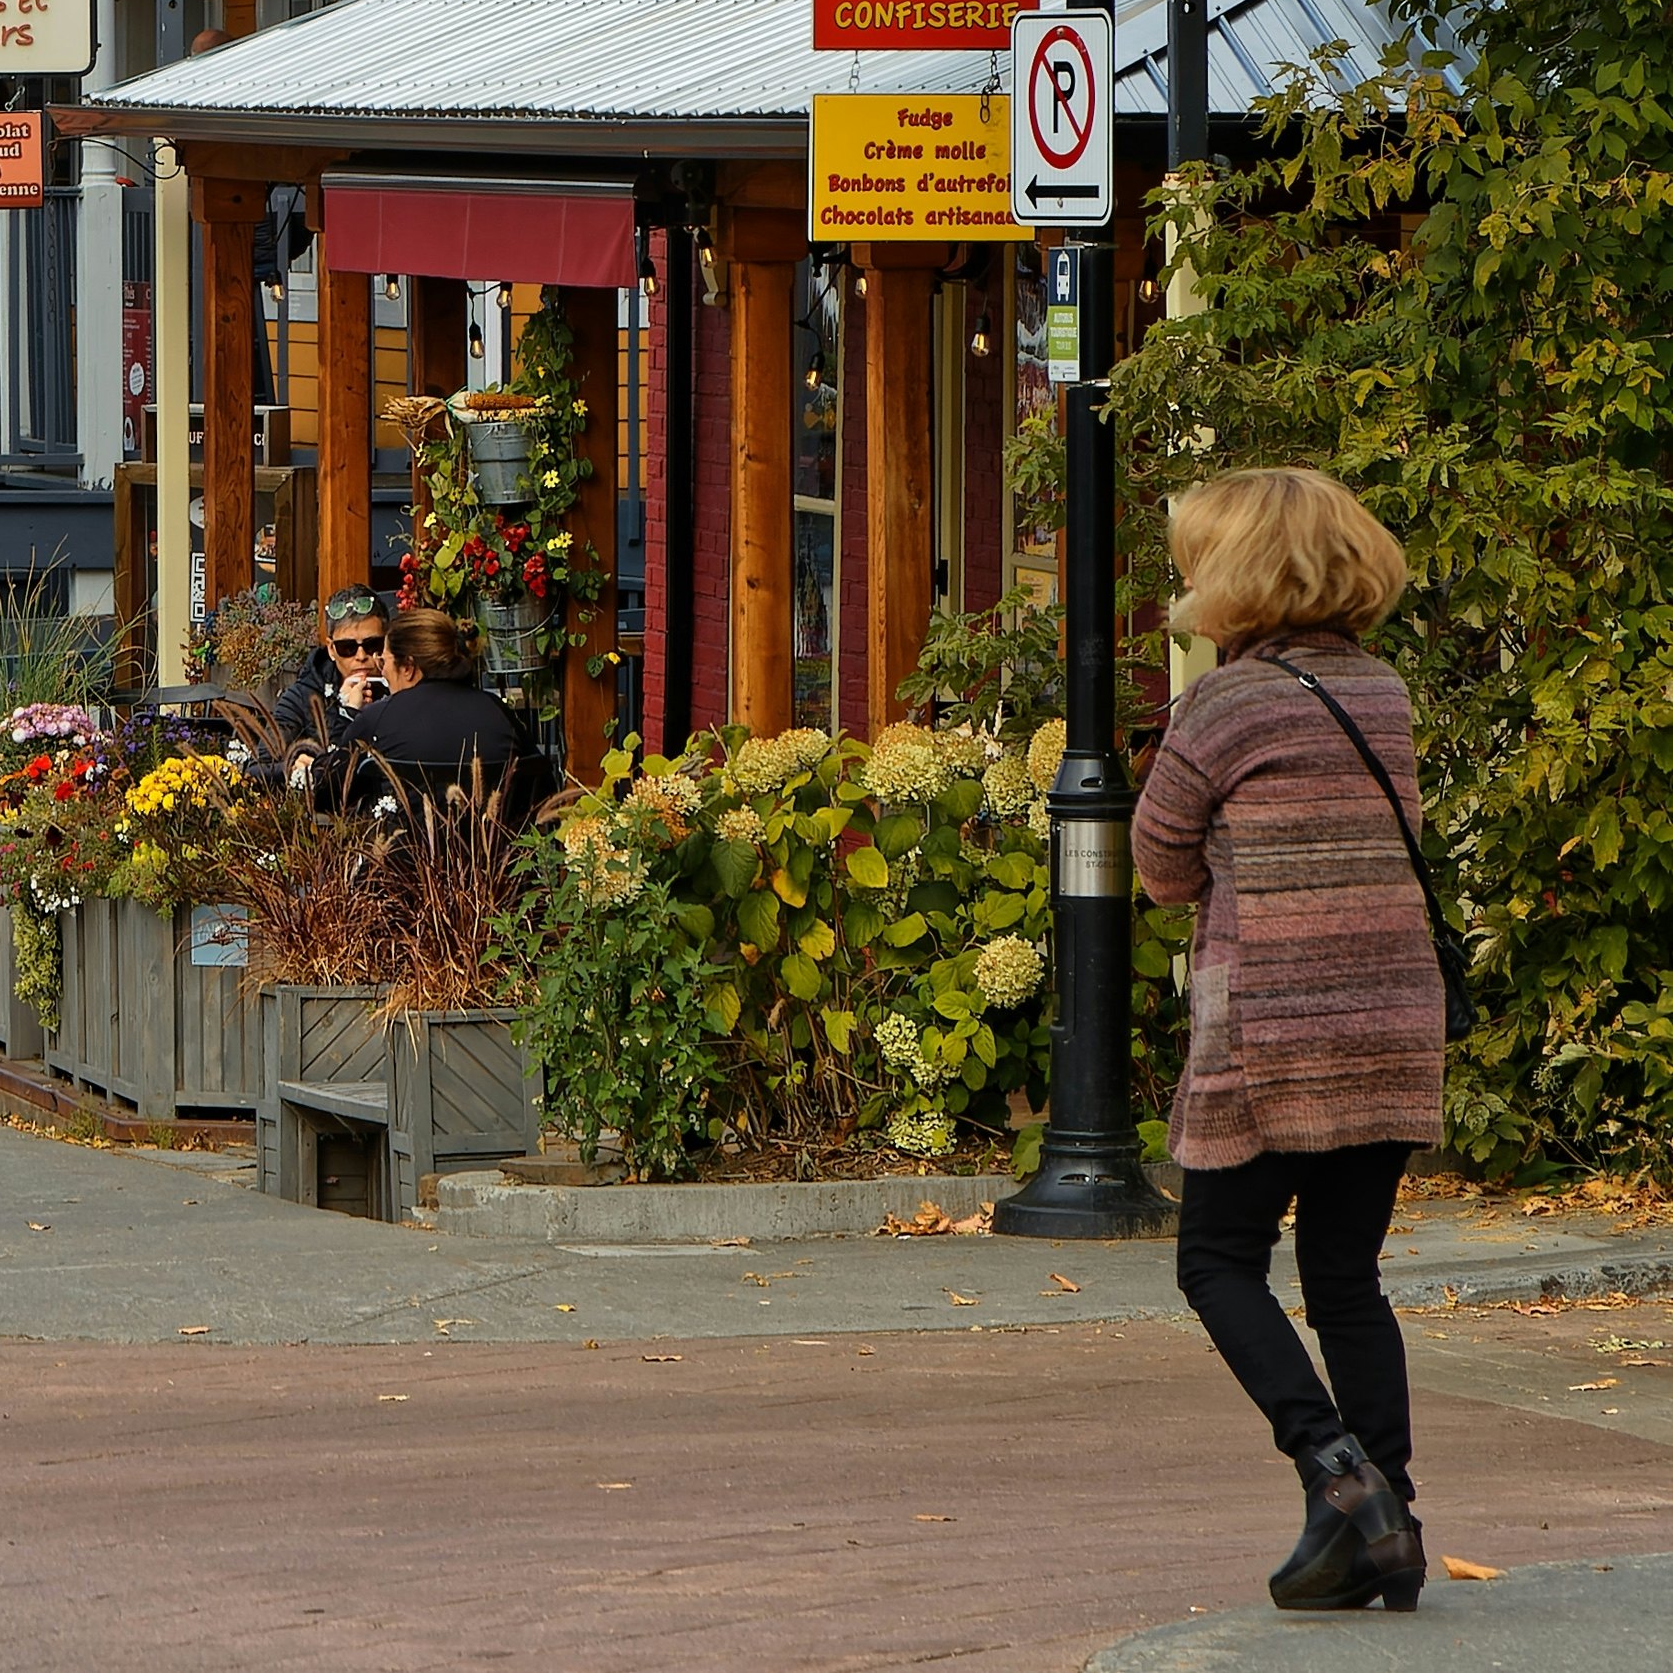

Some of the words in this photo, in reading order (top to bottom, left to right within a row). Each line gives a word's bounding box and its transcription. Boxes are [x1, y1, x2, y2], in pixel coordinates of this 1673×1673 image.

[834, 0, 1021, 31] CONFISERIE
[897, 108, 953, 131] Fudge
[864, 139, 924, 160] Crème
[935, 140, 987, 161] molle
[828, 173, 906, 193] Bonbons
[917, 172, 1011, 193] d'autrefoi
[820, 204, 914, 226] Chocolats
